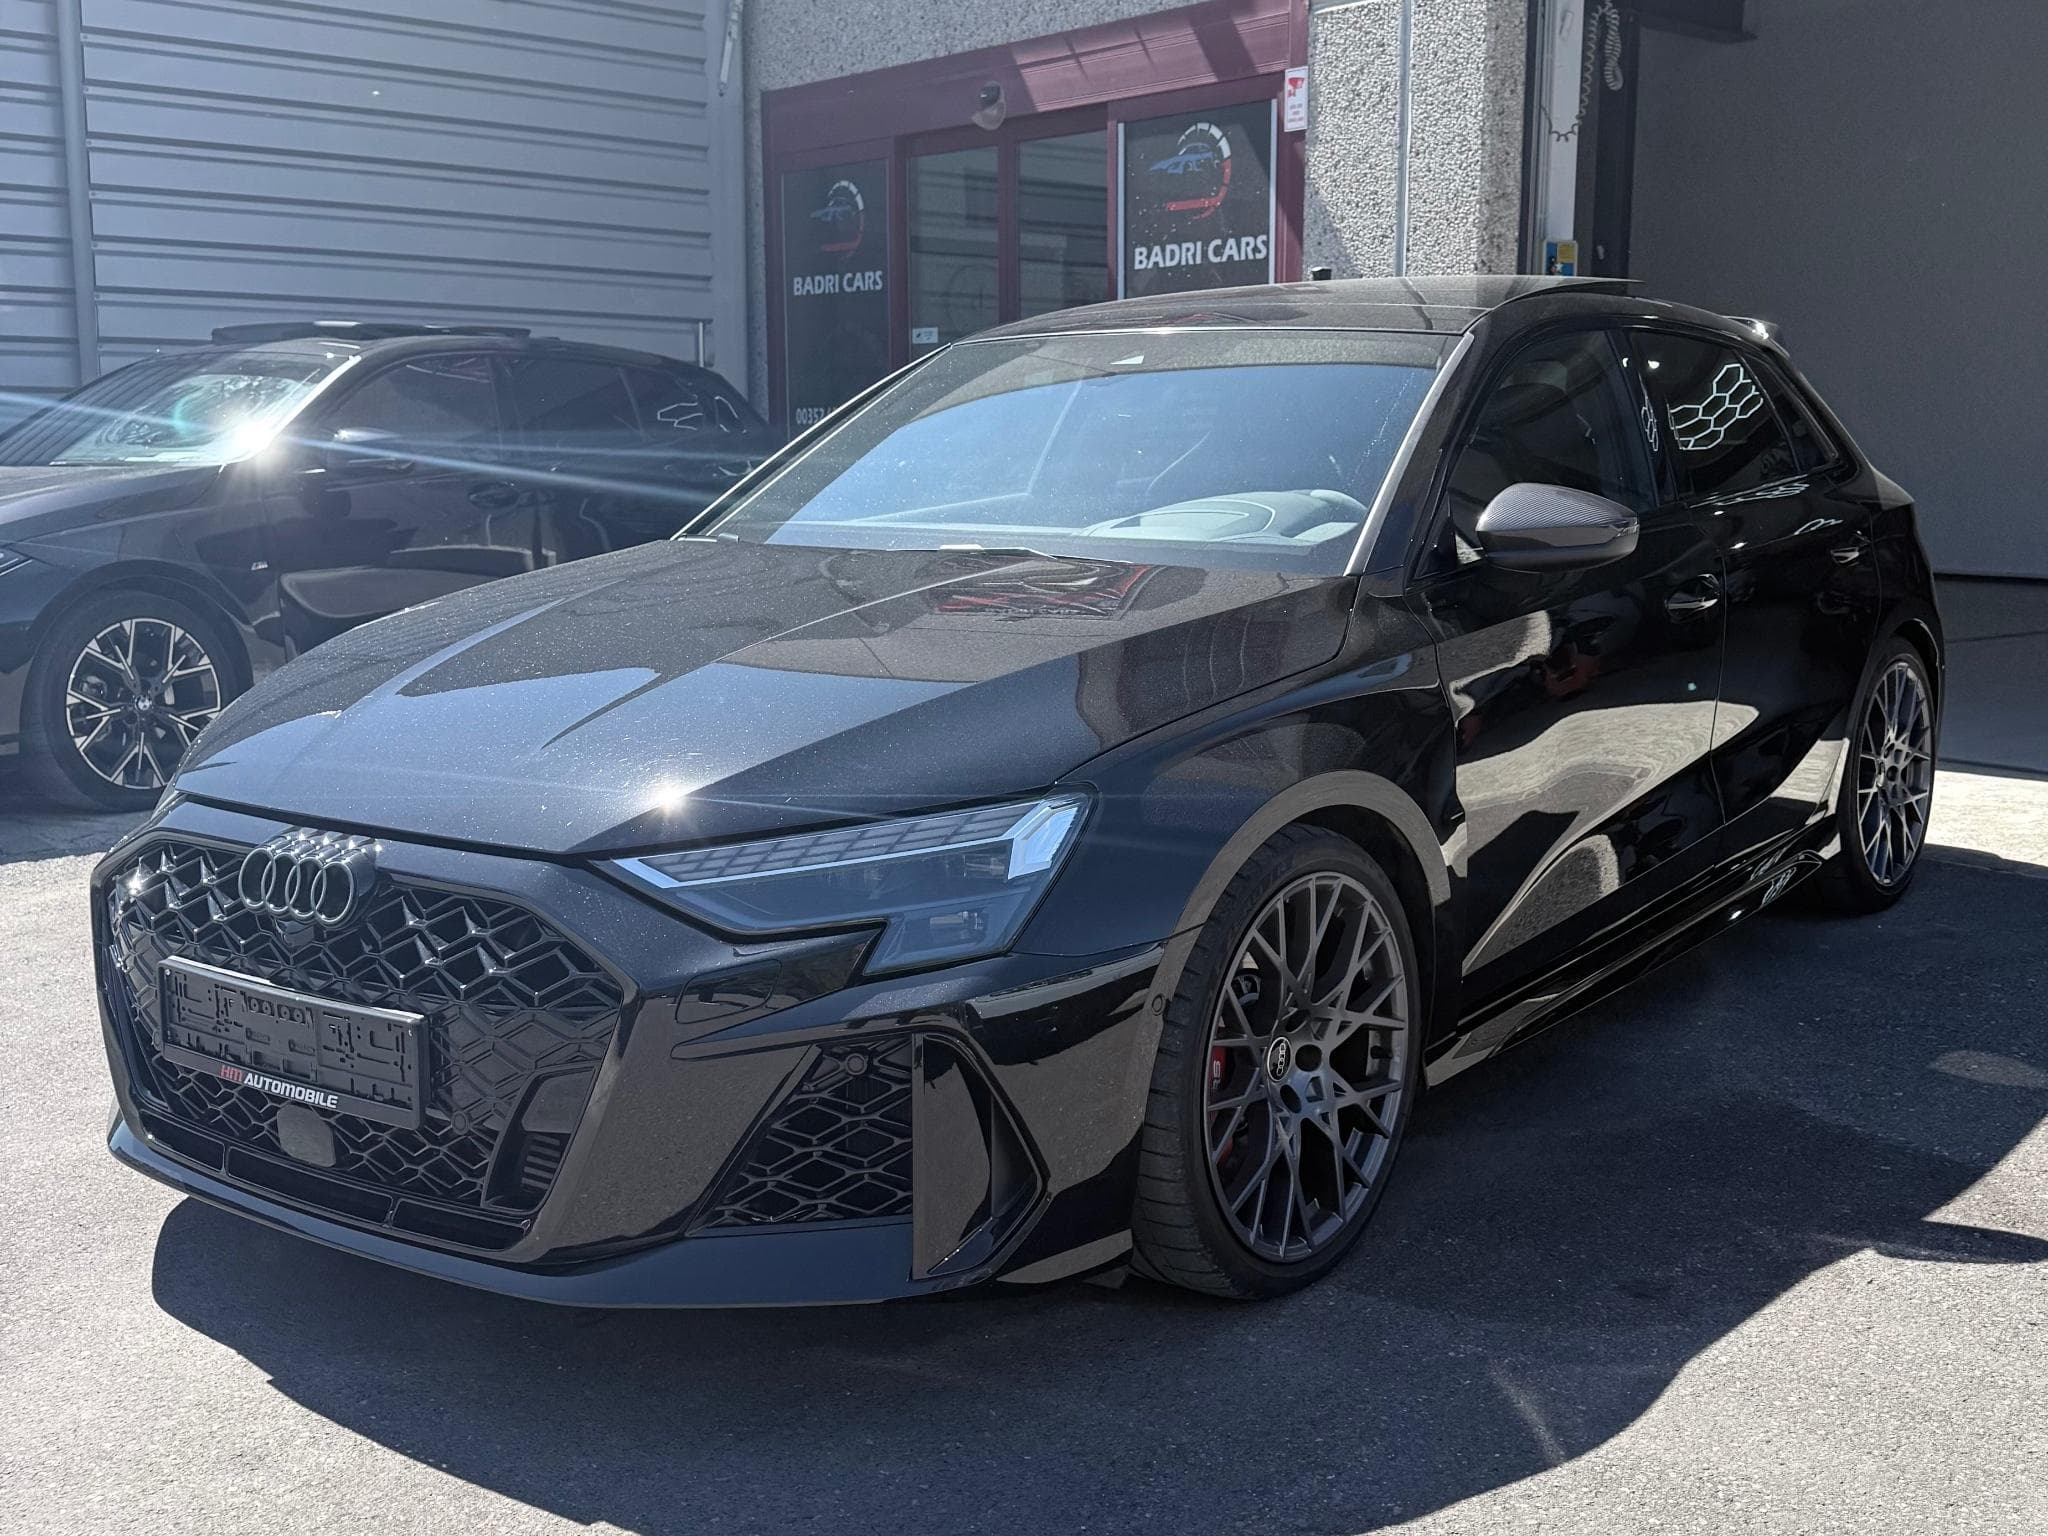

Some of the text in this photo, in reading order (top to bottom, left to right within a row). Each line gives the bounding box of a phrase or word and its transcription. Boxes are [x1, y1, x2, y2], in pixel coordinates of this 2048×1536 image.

[1134, 234, 1268, 269] BADRI CARS
[793, 270, 883, 296] BADRI CARS
[244, 1073, 338, 1108] AUTOMOBILE
